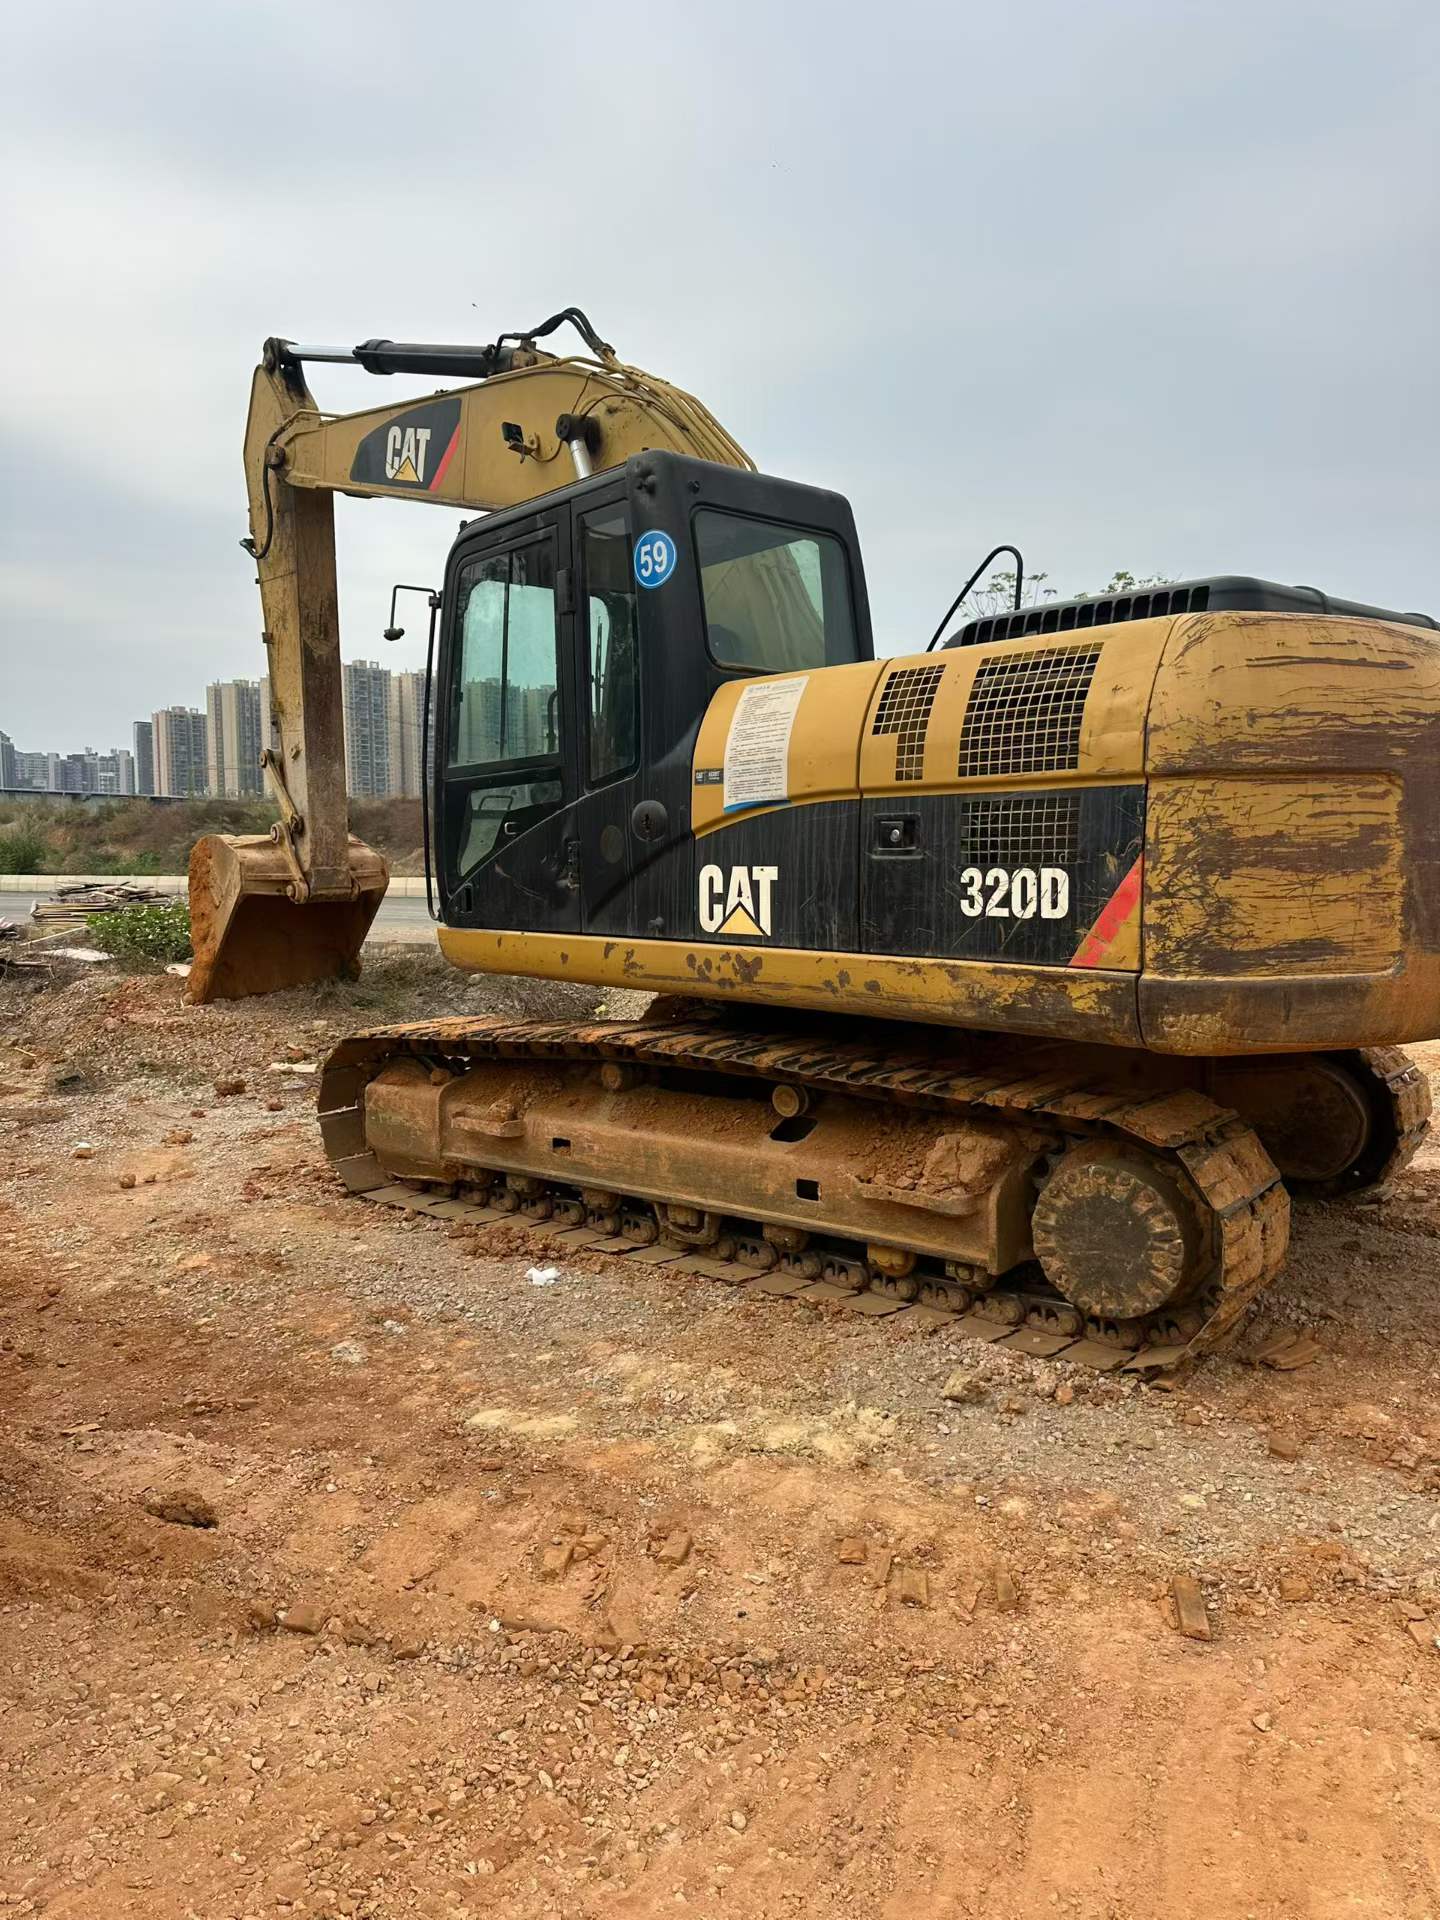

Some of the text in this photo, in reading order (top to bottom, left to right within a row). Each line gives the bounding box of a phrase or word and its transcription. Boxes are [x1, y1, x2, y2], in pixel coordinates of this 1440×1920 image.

[386, 426, 431, 482] CAT
[641, 541, 667, 577] 59
[699, 864, 778, 936] CAT
[960, 867, 1069, 919] 320D
